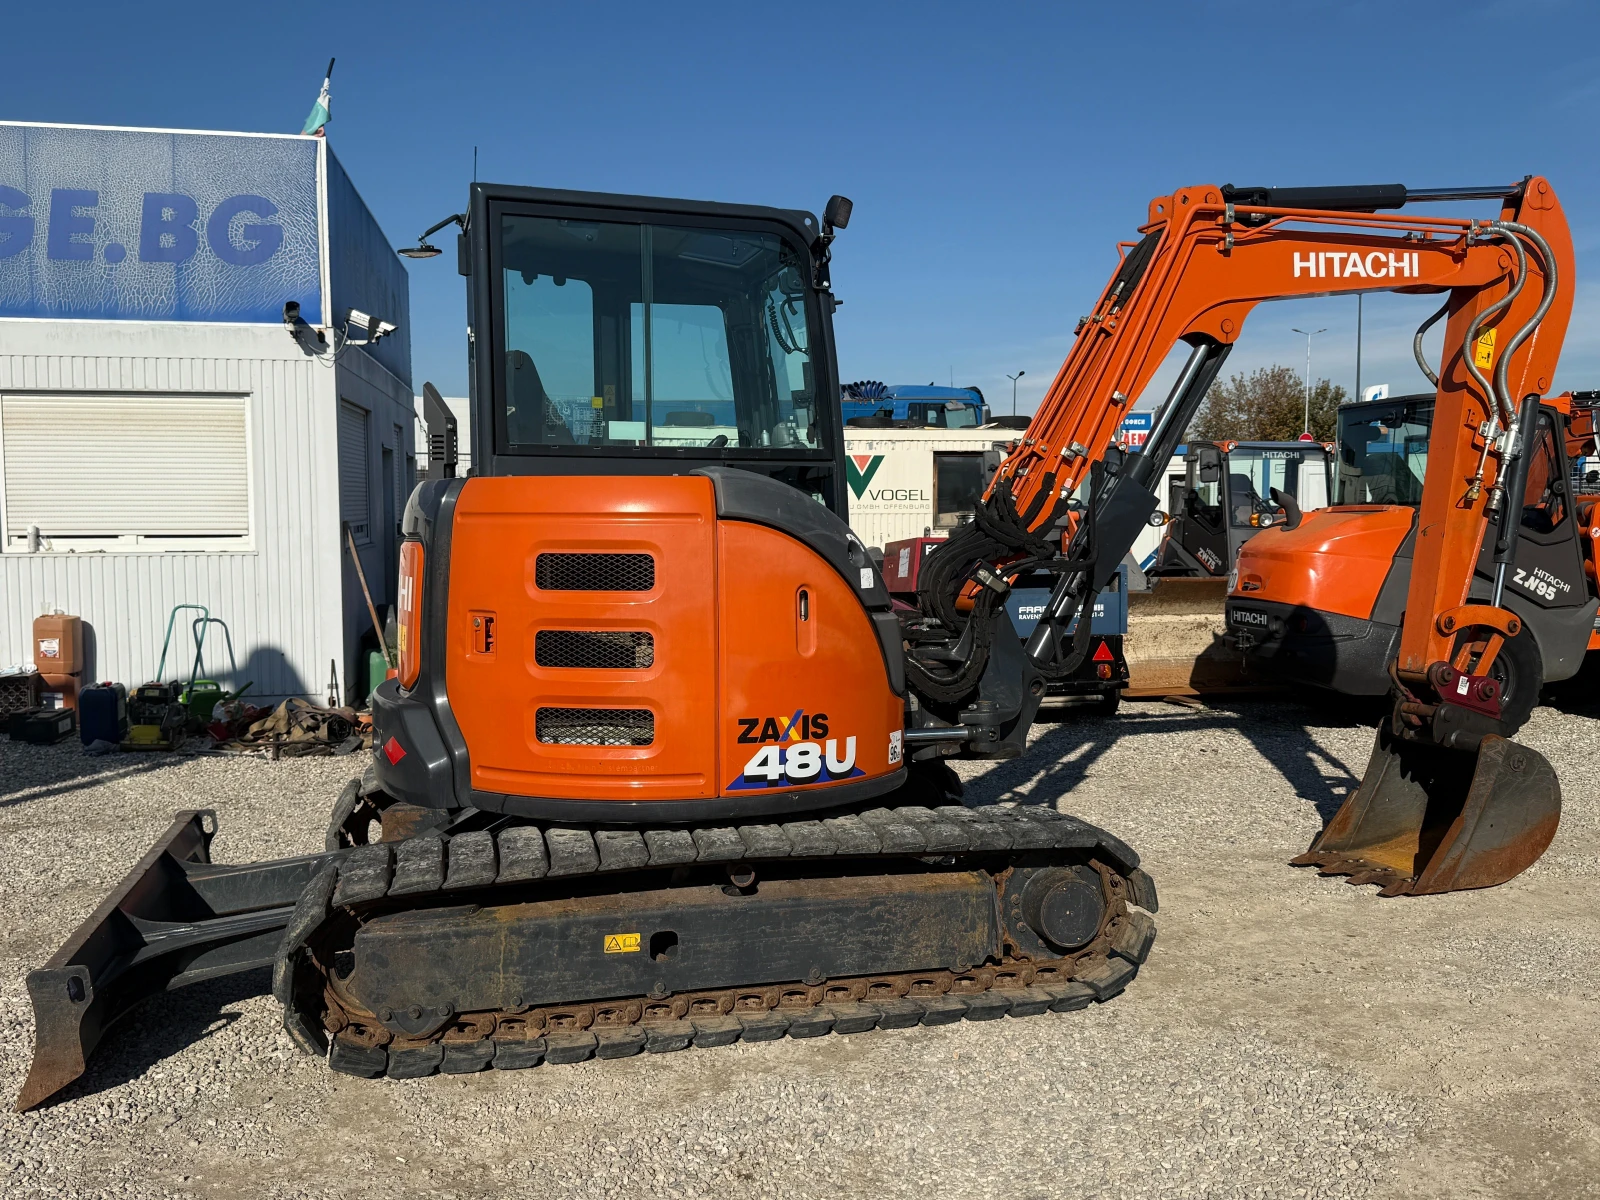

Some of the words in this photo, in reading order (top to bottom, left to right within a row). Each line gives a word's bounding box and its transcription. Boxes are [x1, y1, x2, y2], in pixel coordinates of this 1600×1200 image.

[1293, 251, 1419, 278] HITACHI
[1262, 451, 1300, 459] HITACHI
[868, 489, 930, 501] VOGEL
[1197, 547, 1216, 570] ZW75
[1533, 566, 1571, 593] HITACHI
[1233, 610, 1268, 626] HITACHI
[737, 709, 829, 744] ZAXIS
[743, 735, 857, 785] 48U
